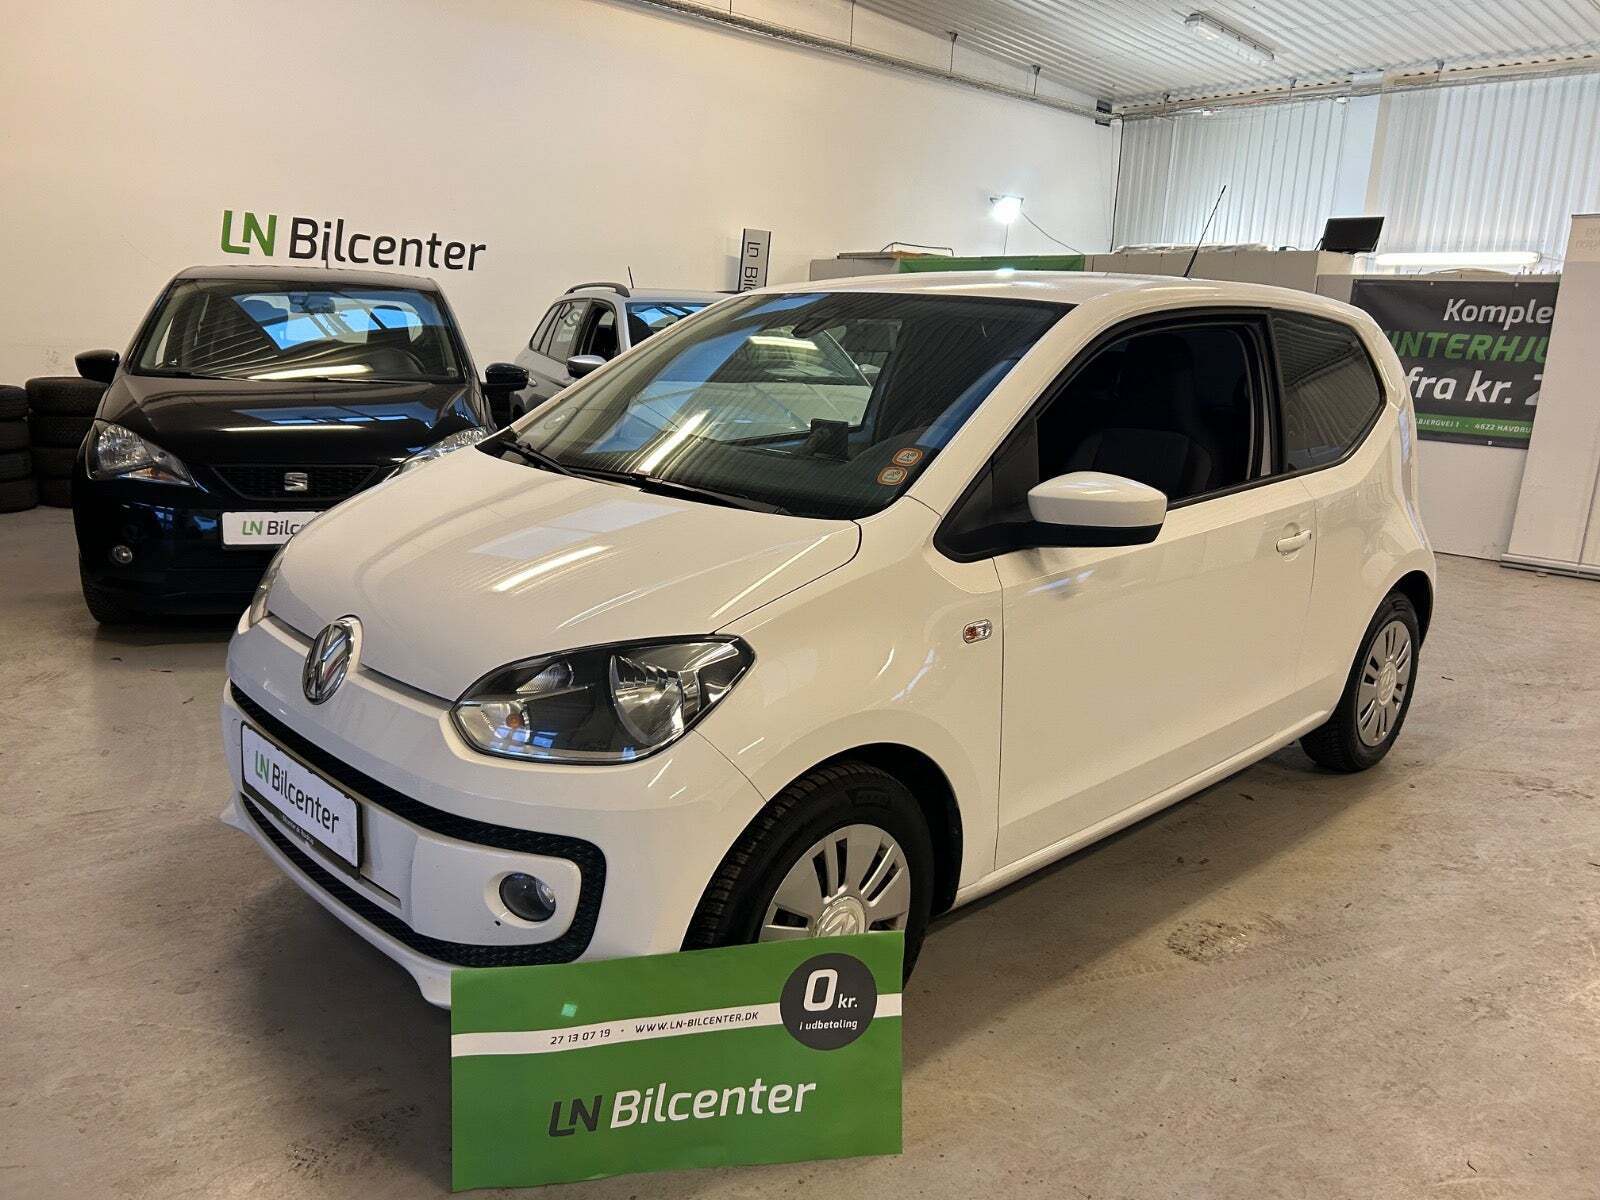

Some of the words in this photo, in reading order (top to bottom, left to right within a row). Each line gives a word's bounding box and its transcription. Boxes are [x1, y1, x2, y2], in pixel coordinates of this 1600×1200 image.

[221, 209, 277, 257] LN
[289, 216, 487, 271] Bilcenter
[743, 266, 759, 291] Bilc
[1443, 298, 1553, 331] Komple
[1384, 330, 1551, 364] INTERHJU
[1405, 366, 1457, 401] fra
[1465, 369, 1513, 405] kr.
[1415, 418, 1454, 428] BJERGVEJ
[1474, 423, 1495, 431] 4622
[1497, 424, 1532, 434] HAVDRU
[242, 520, 263, 536] LN
[266, 519, 305, 536] Bilc
[255, 750, 270, 785] LN
[271, 762, 340, 834] Bilcenter
[803, 968, 839, 1012] 0
[837, 993, 858, 1009] kr.
[550, 1035, 564, 1046] 27
[567, 1033, 579, 1044] 13
[582, 1031, 597, 1042] 07
[599, 1028, 611, 1039] 19
[635, 1011, 760, 1034] WWW.LN-BILCENTER.DK
[805, 1020, 858, 1031] udbetaling
[548, 1094, 603, 1138] LN
[609, 1077, 817, 1130] Bilcenter
